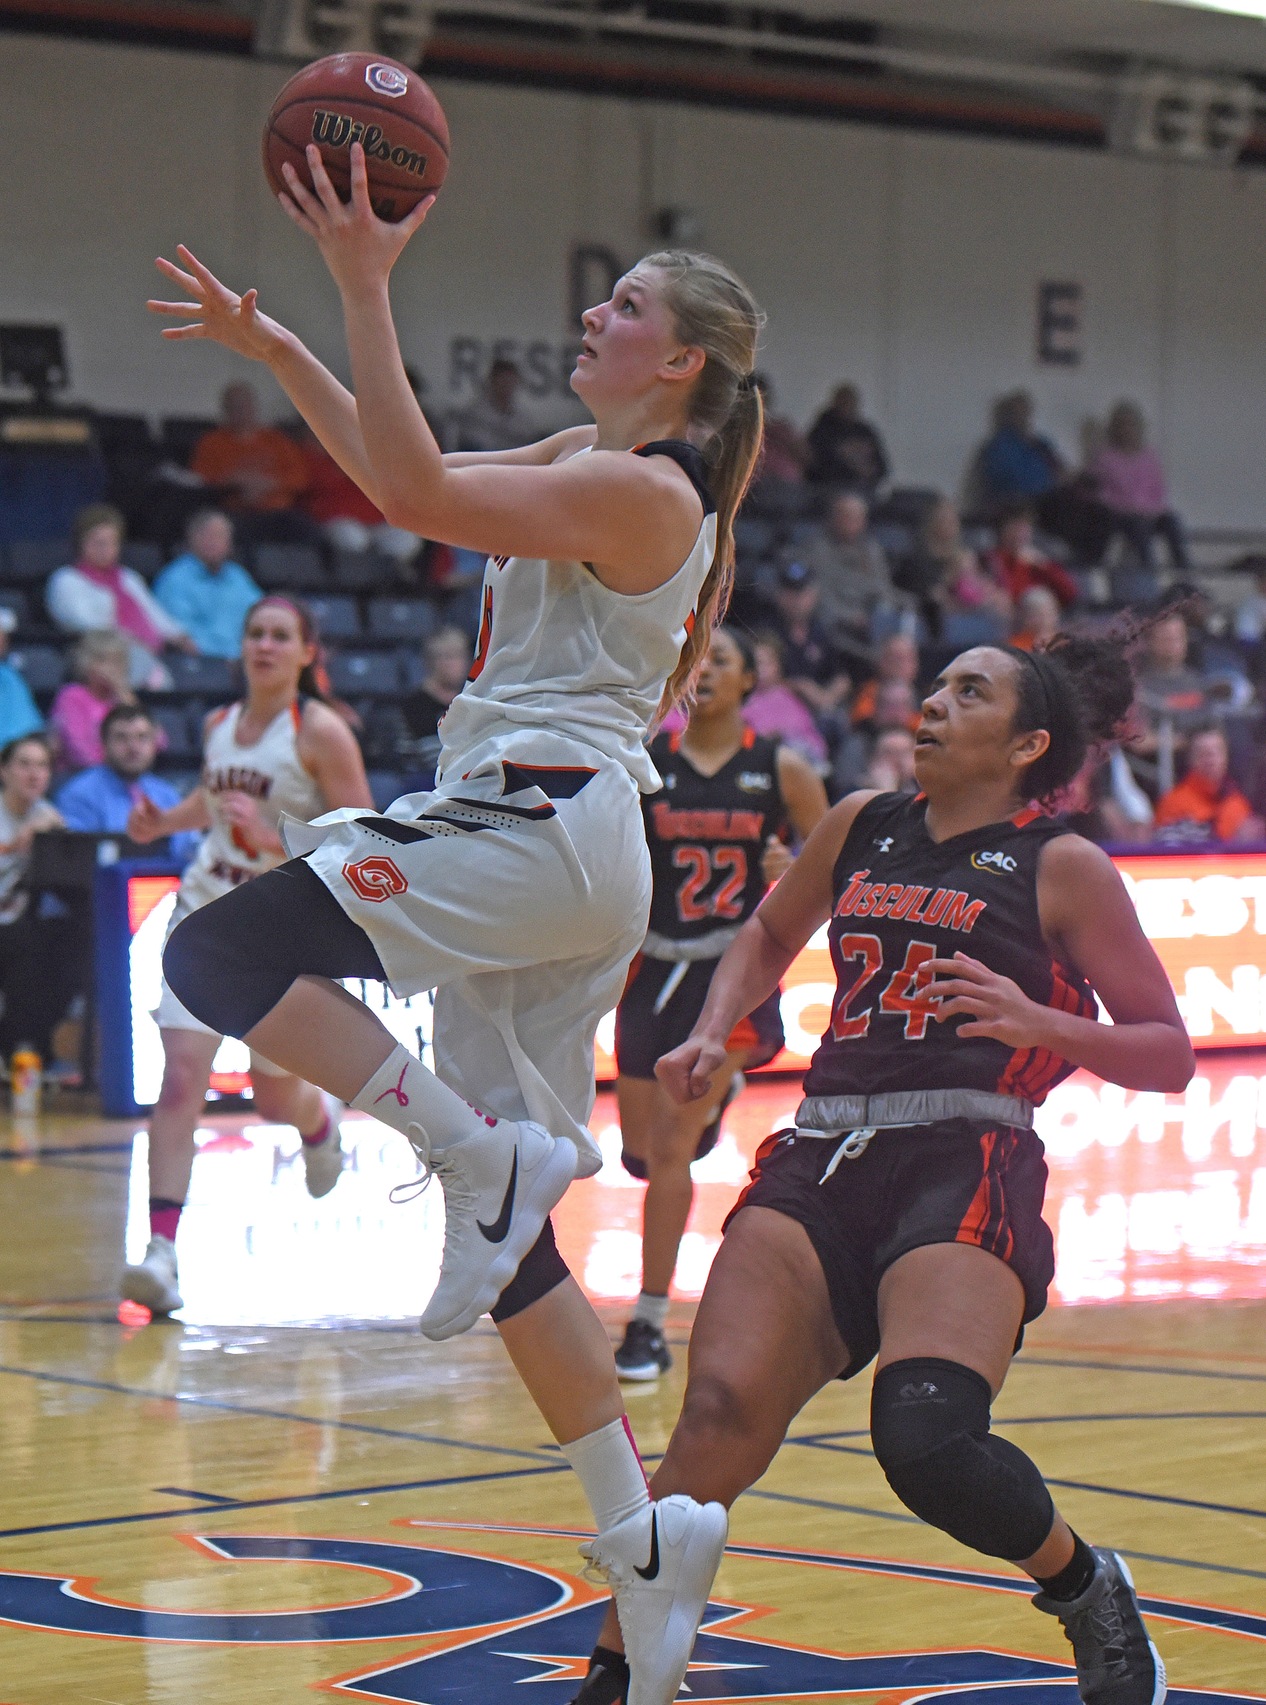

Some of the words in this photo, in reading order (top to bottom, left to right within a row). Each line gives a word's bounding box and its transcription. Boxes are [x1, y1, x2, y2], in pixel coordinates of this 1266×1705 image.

[311, 108, 428, 179] Wilson
[1036, 280, 1082, 368] E
[672, 845, 748, 922] 22
[976, 851, 1018, 872] SAC
[834, 869, 987, 933] TUSCULUM
[832, 933, 944, 1042] 24
